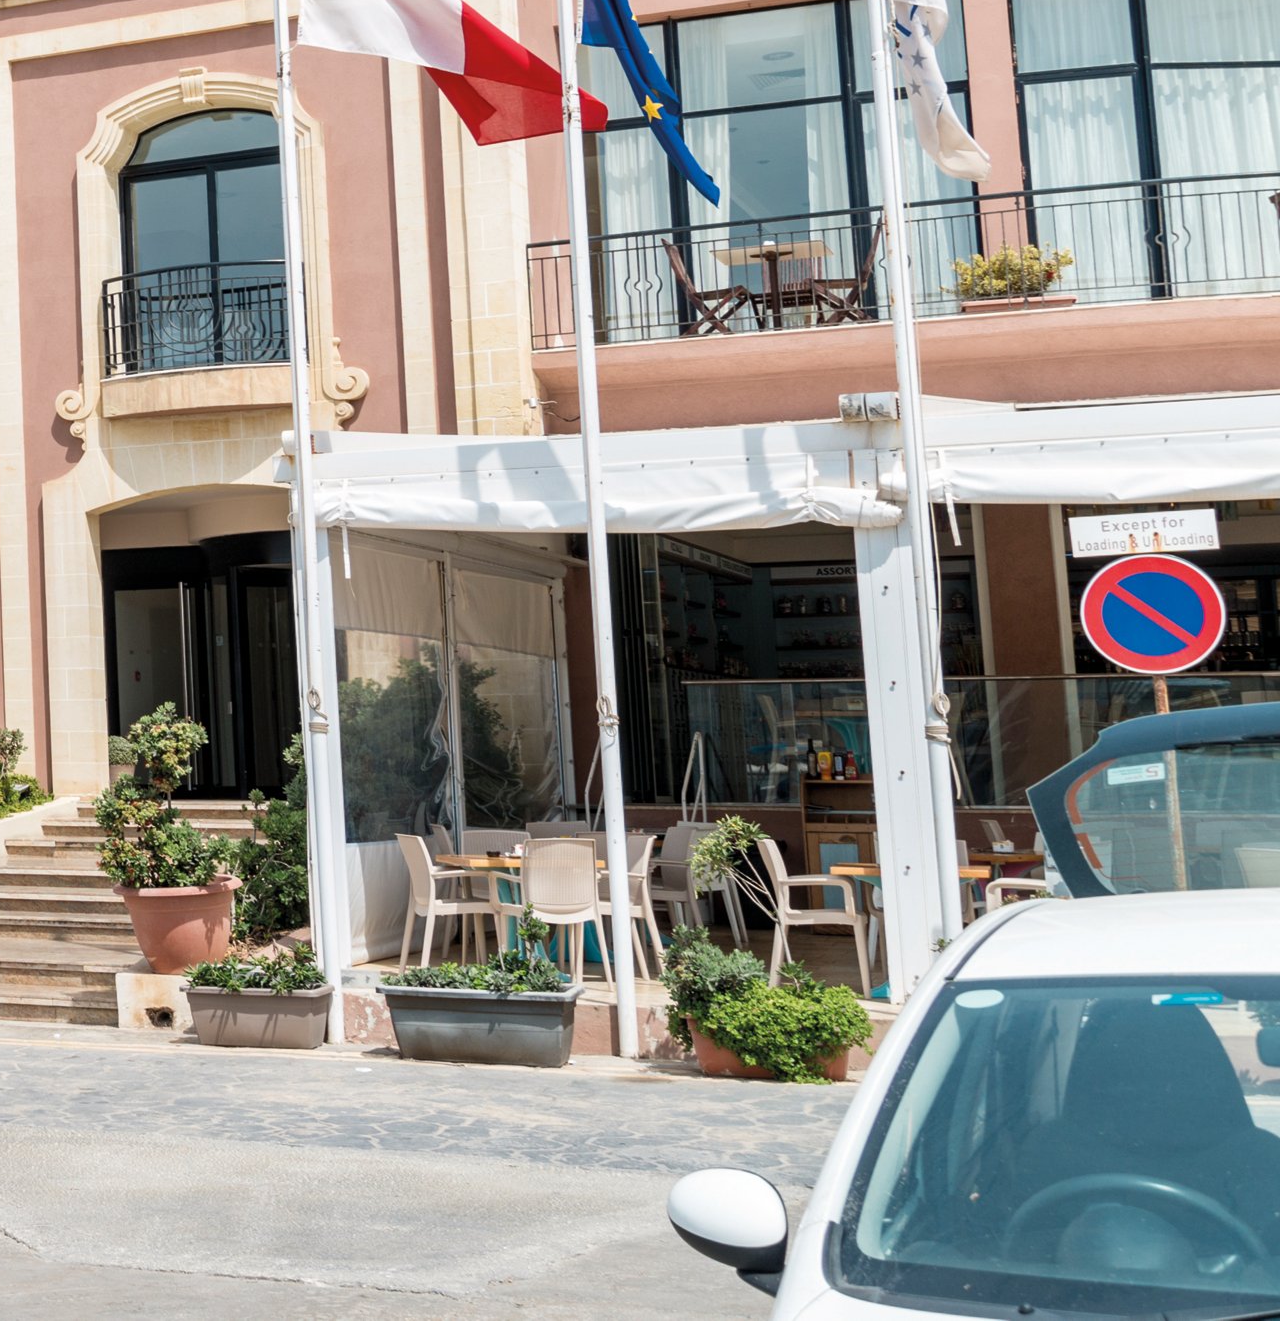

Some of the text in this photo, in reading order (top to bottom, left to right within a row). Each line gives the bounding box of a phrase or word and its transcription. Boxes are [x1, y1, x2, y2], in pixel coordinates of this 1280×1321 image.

[1100, 516, 1185, 532] Except for
[1077, 539, 1126, 552] Loading
